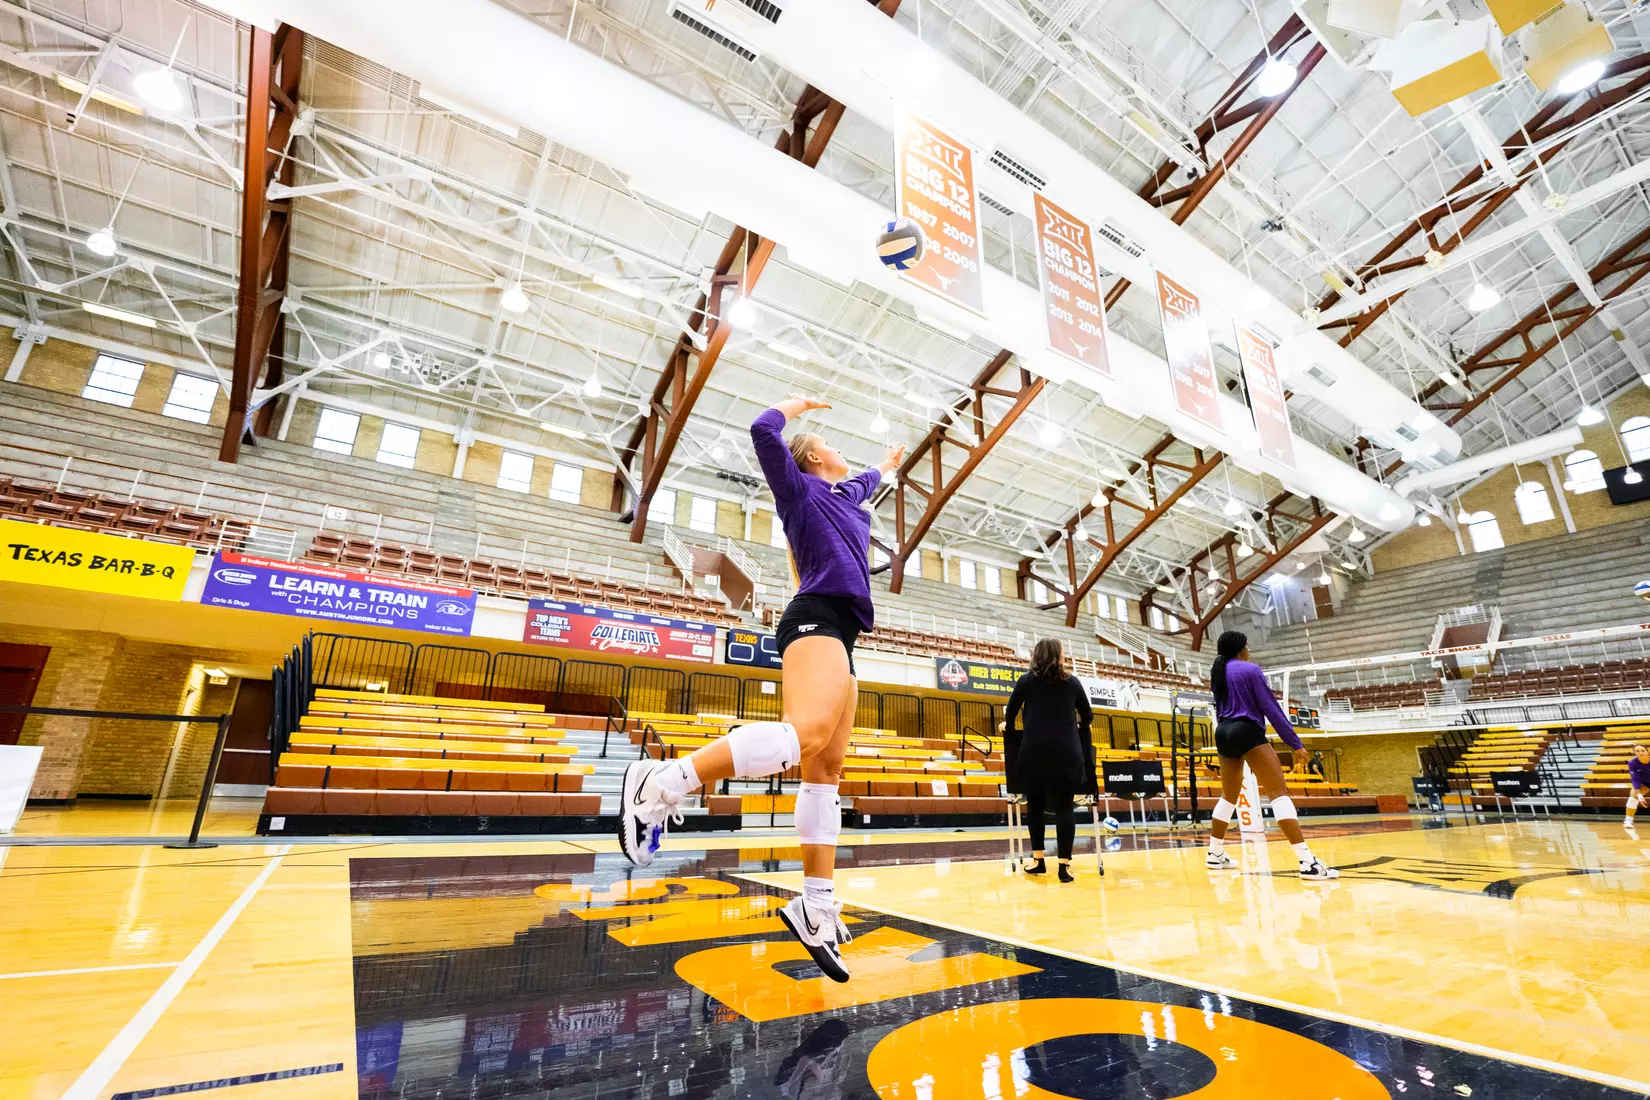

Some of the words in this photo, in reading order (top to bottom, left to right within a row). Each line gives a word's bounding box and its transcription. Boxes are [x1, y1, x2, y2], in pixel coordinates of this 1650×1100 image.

[906, 154, 945, 193] BIG
[948, 179, 970, 208] 12
[906, 176, 972, 222] CHAMPION
[906, 201, 937, 228] 1997
[942, 221, 975, 248] 2007
[944, 246, 977, 273] 2009
[1043, 236, 1074, 268] BIG
[1075, 255, 1093, 280] 12
[1045, 257, 1096, 292] CHAMPION
[1048, 281, 1070, 303] 2011
[1076, 295, 1099, 317] 2012
[1050, 304, 1074, 325] 2013
[1078, 319, 1102, 339] 2014
[8, 544, 83, 567] TEXAS
[88, 555, 175, 579] BAR-B-Q
[247, 558, 269, 566] Indoor
[270, 561, 297, 570] National
[297, 564, 347, 578] Championships
[268, 574, 345, 598] LEARN
[349, 588, 361, 598] &
[367, 588, 428, 609] TRAIN
[390, 579, 415, 588] National
[415, 583, 458, 594] Championships
[233, 599, 250, 607] Boys
[288, 593, 418, 619] CHAMPIONS
[425, 623, 442, 631] Indoor
[530, 621, 572, 631] COLLEGIATE
[535, 614, 549, 622] TOP
[549, 616, 569, 626] MEN'S
[540, 627, 561, 637] TEAMS
[590, 624, 660, 646] COLLEGIATE
[734, 633, 758, 645] TEXAS
[599, 638, 650, 654] Challenge
[1448, 645, 1481, 653] SHACK
[990, 668, 1012, 681] SPACE
[1090, 686, 1115, 698] SIMPLE
[1109, 773, 1133, 782] molten
